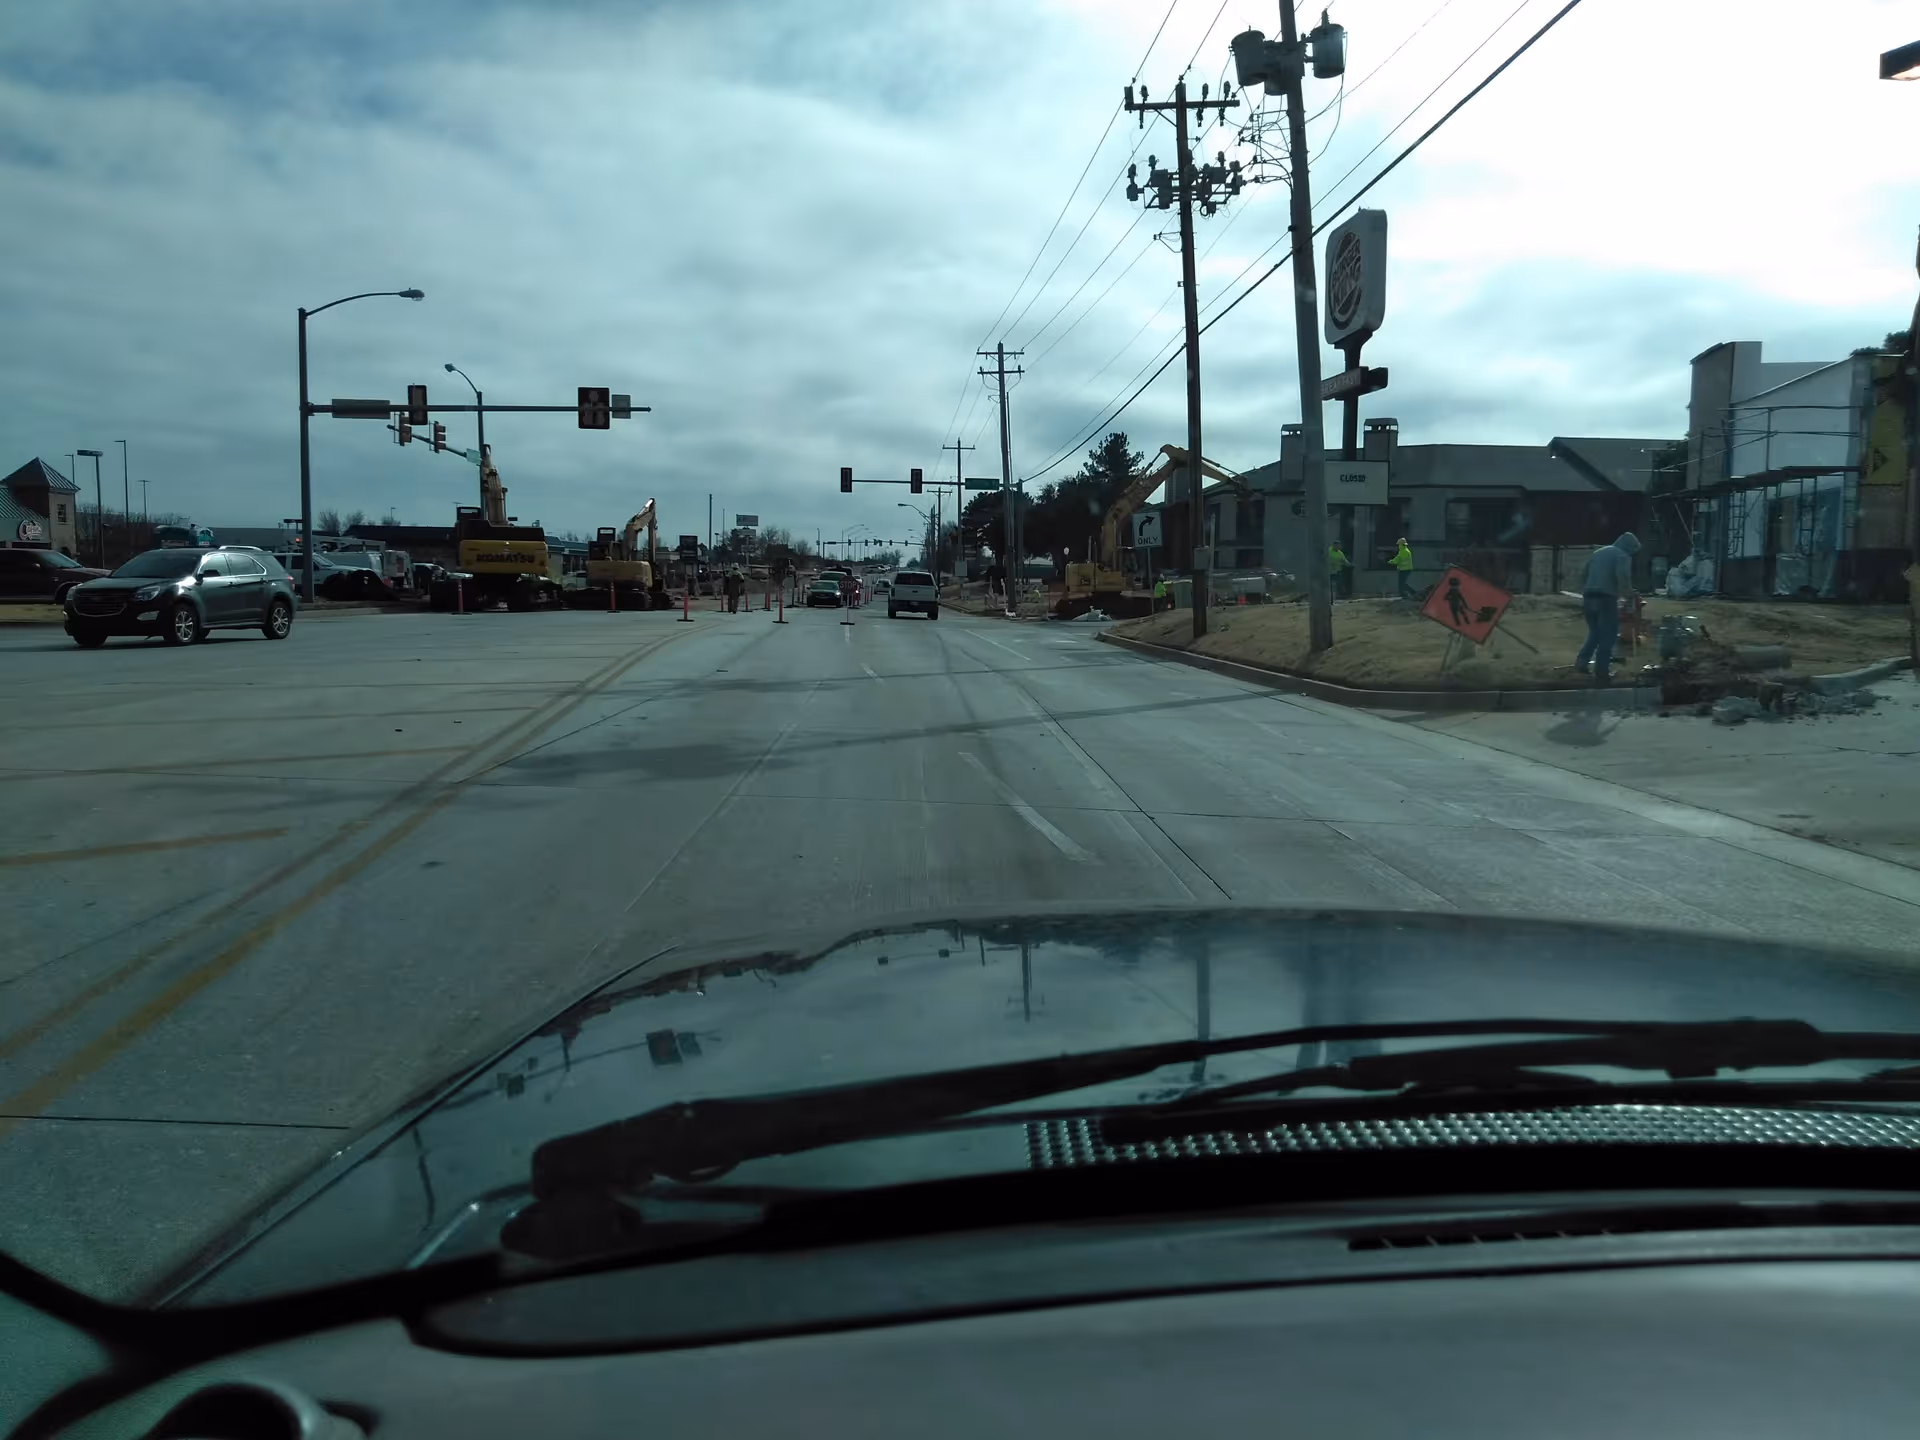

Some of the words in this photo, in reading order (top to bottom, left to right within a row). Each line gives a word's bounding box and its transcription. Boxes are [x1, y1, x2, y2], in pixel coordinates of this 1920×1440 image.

[1332, 240, 1361, 286] BURGER
[1333, 257, 1361, 307] KING
[1340, 474, 1366, 483] CLOSED
[1137, 536, 1158, 545] ONLY
[839, 580, 857, 590] STOP
